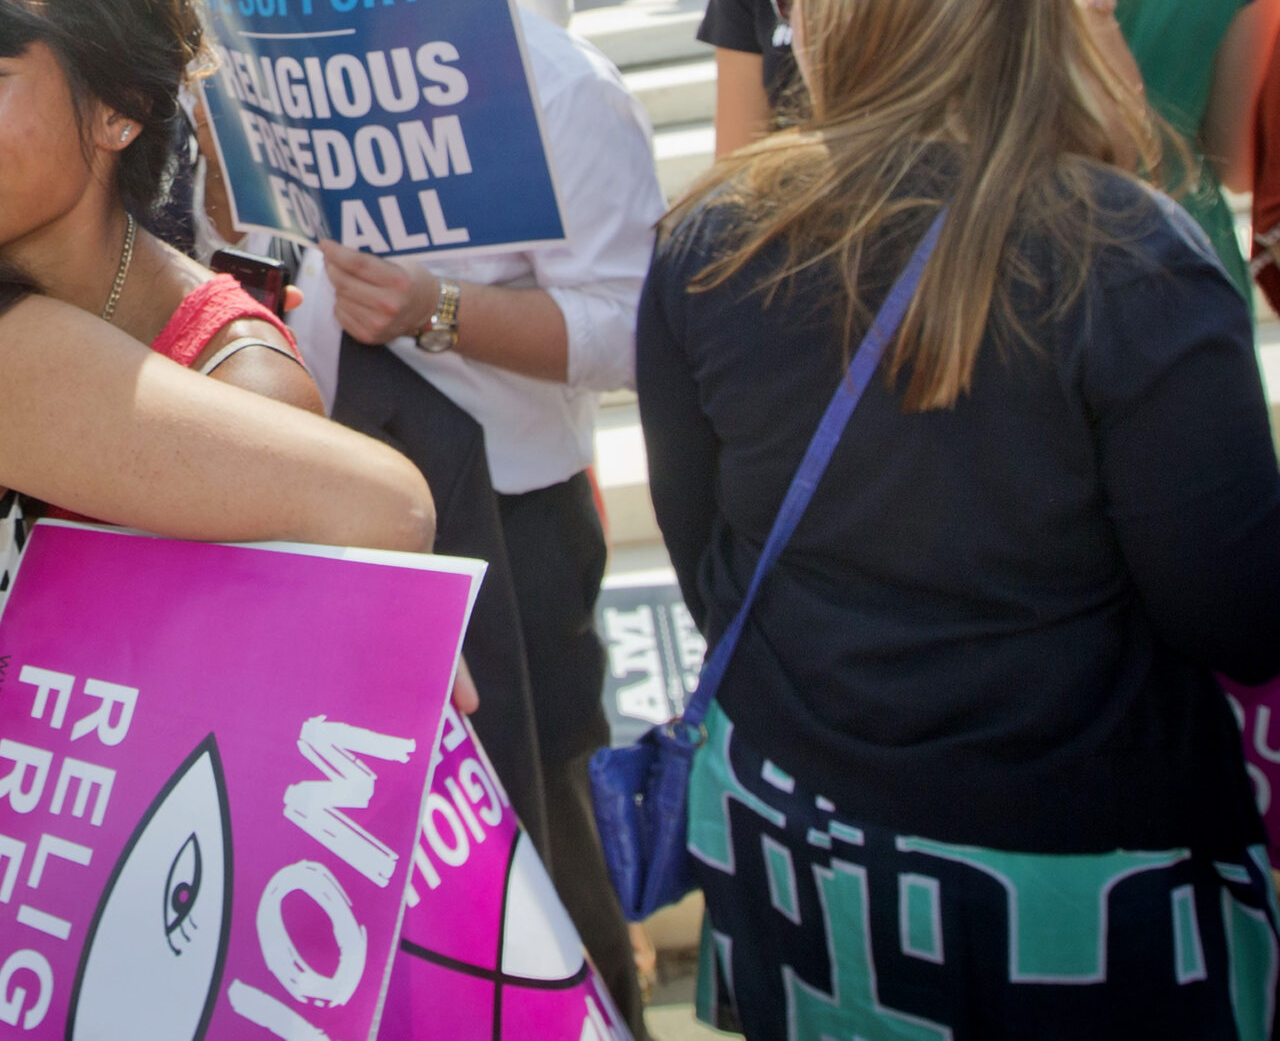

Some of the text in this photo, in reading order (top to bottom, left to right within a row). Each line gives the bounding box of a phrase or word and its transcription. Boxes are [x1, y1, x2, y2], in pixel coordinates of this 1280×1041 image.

[220, 40, 469, 120] RELIGIOUS
[240, 114, 473, 191] FREEDOM
[340, 188, 470, 255] ALL
